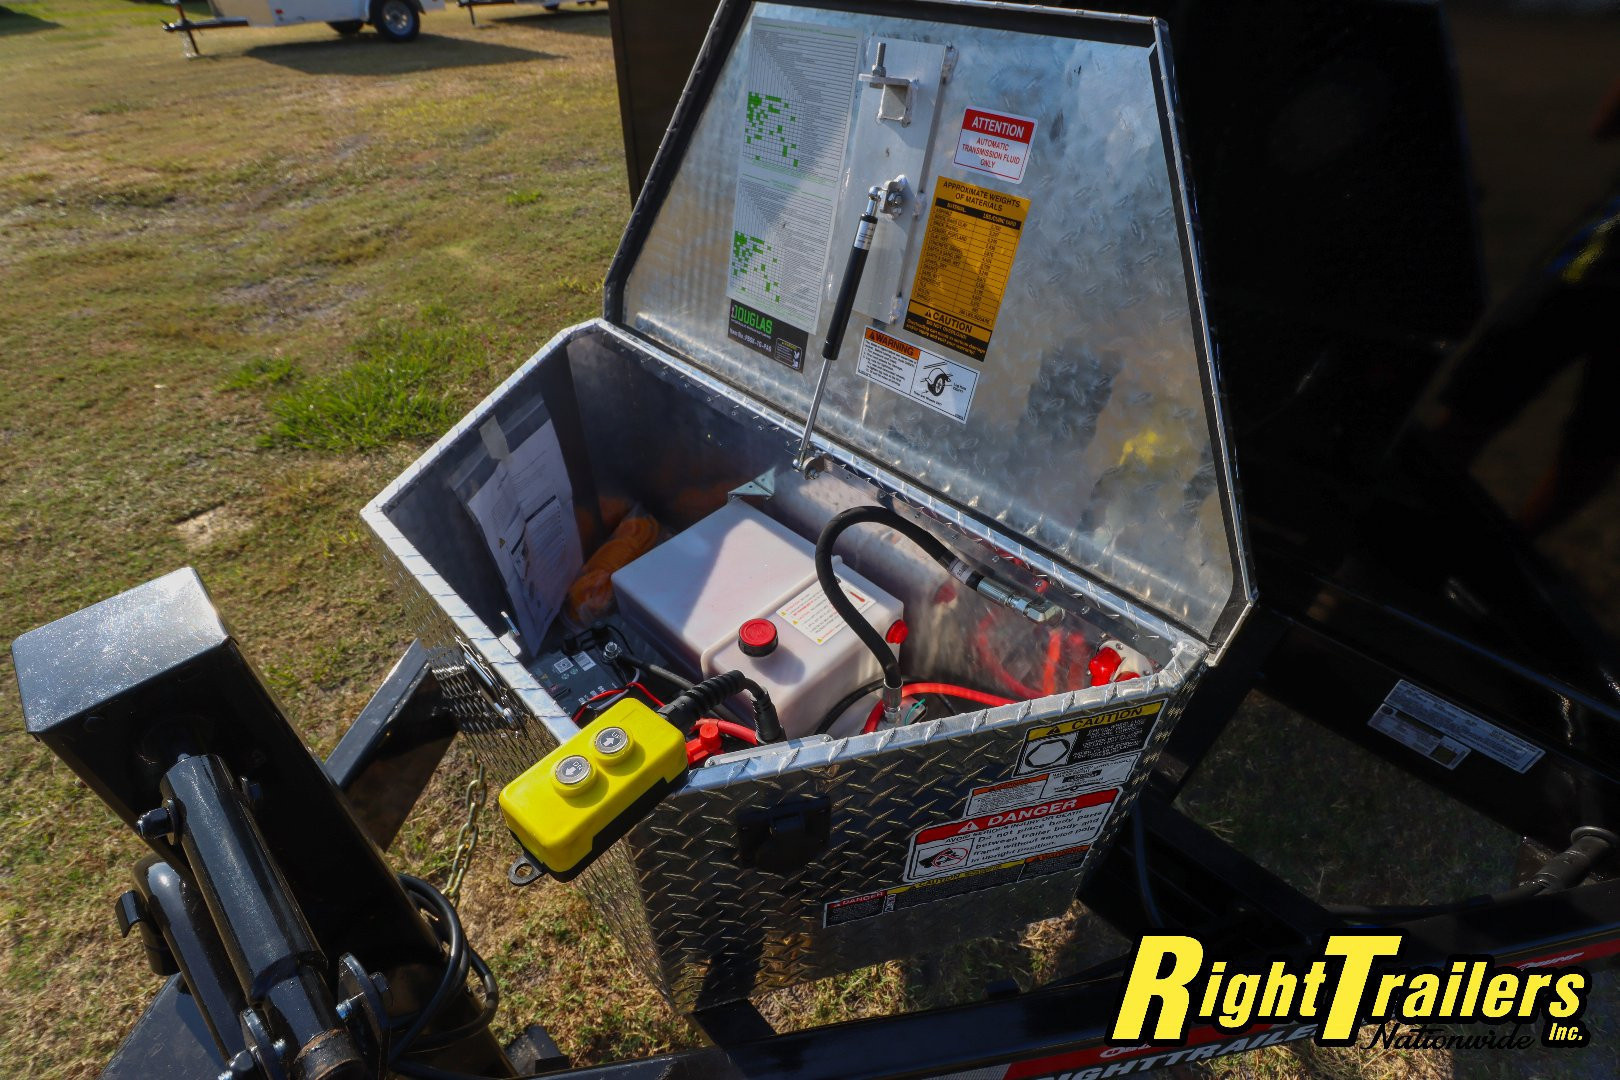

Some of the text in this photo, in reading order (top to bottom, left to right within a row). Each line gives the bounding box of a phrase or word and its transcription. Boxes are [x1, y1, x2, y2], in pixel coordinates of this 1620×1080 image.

[972, 116, 1025, 138] ATTENTION
[962, 143, 1021, 165] TRANSMISSION FLUID
[976, 137, 1010, 151] AUTOMATIC
[980, 158, 996, 168] ONLY
[943, 180, 1021, 208] APPROXIMATE WEIGHTS
[955, 192, 1003, 212] OF MATERIALS
[731, 305, 772, 334] DOUGLAS
[932, 311, 973, 333] CAUTION
[877, 331, 914, 356] WARNING
[1071, 707, 1143, 730] CAUTION
[987, 799, 1078, 826] DANGER
[976, 818, 1100, 849] between trailer body and
[996, 830, 1013, 838] not
[1017, 823, 1045, 835] place
[1049, 817, 1075, 827] body
[1077, 811, 1103, 821] parts
[945, 832, 972, 843] AVOID
[1003, 838, 1039, 848] without
[1040, 831, 1073, 840] service
[1075, 825, 1097, 835] pole
[981, 849, 1016, 860] upright
[842, 891, 885, 905] DANGER
